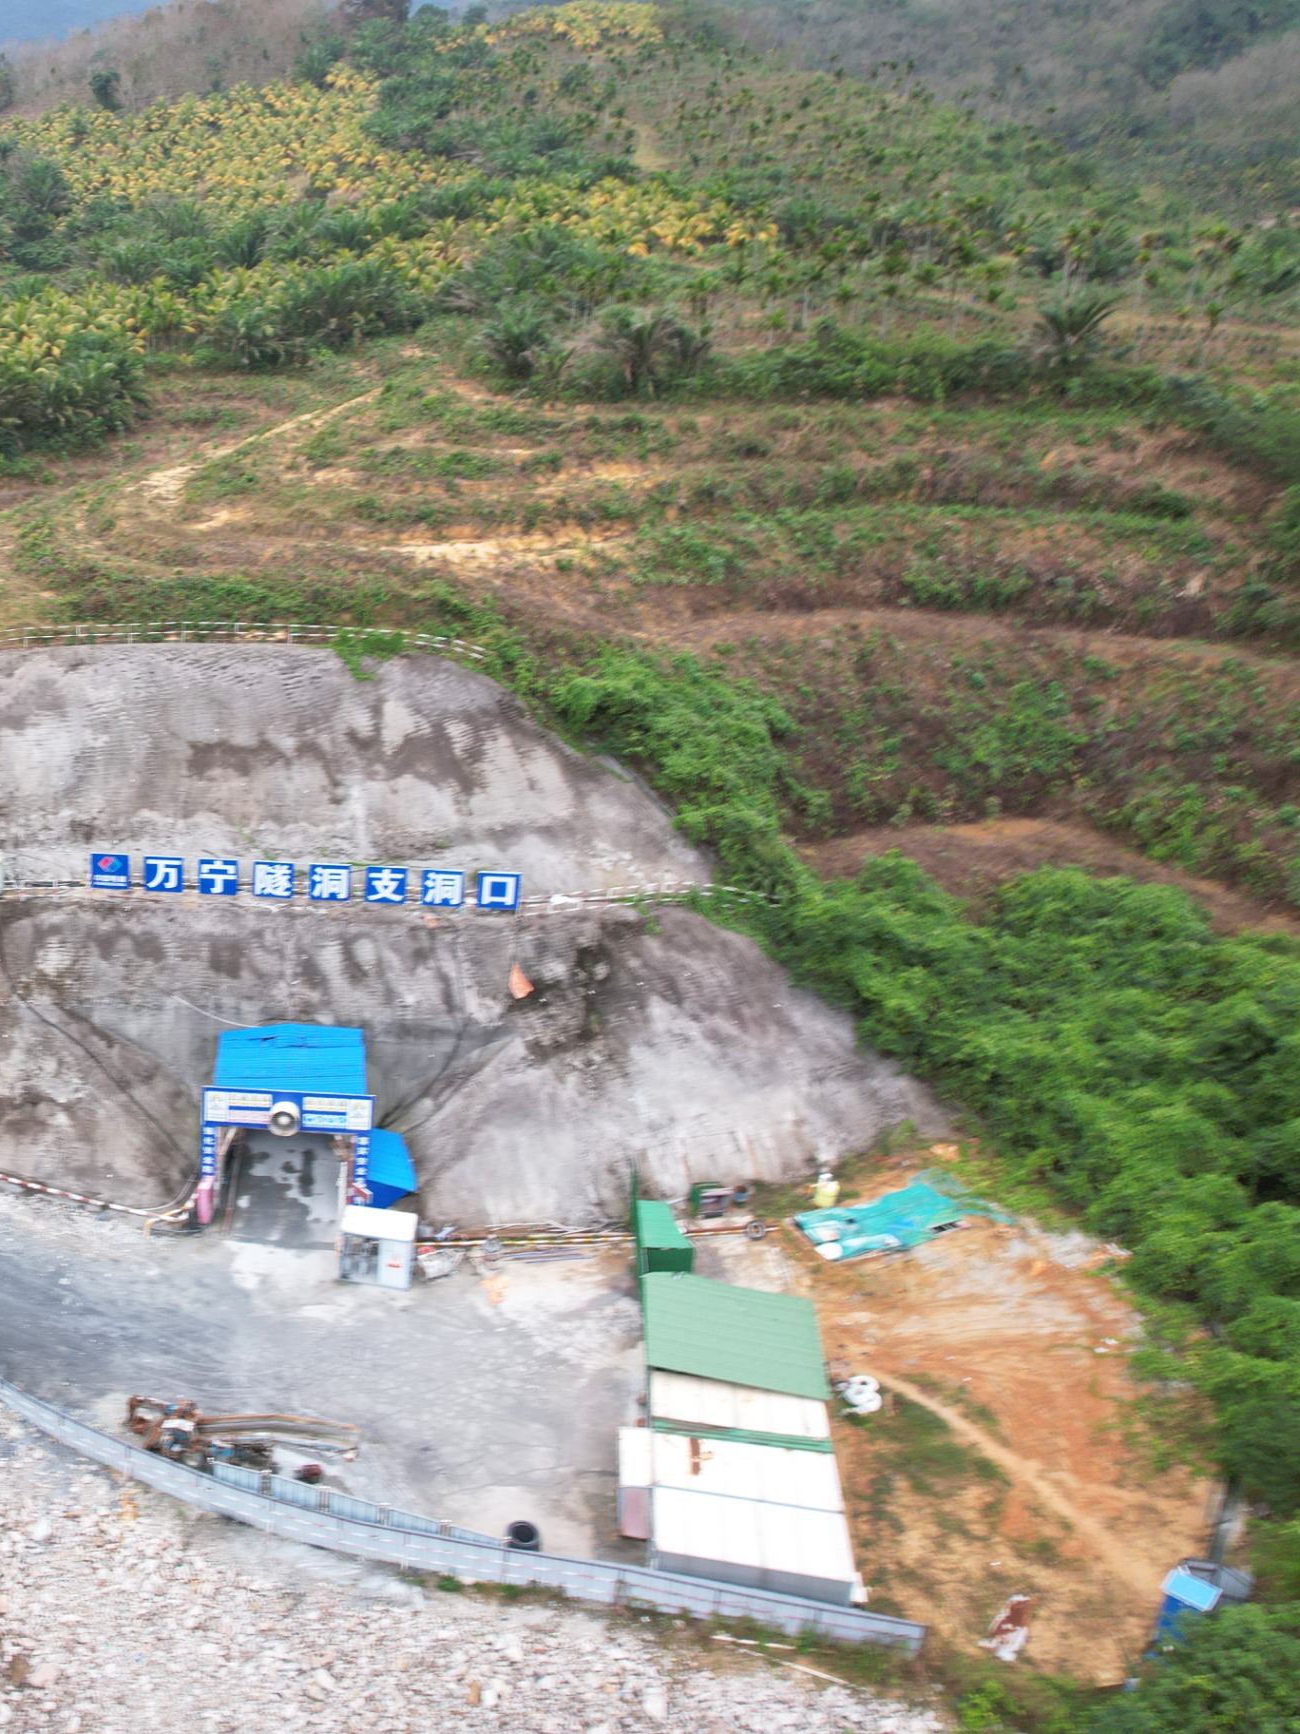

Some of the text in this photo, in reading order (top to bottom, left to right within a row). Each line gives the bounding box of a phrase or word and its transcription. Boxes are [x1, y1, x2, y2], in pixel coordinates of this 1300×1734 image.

[146, 859, 517, 905] 万宁隧洞支洞口
